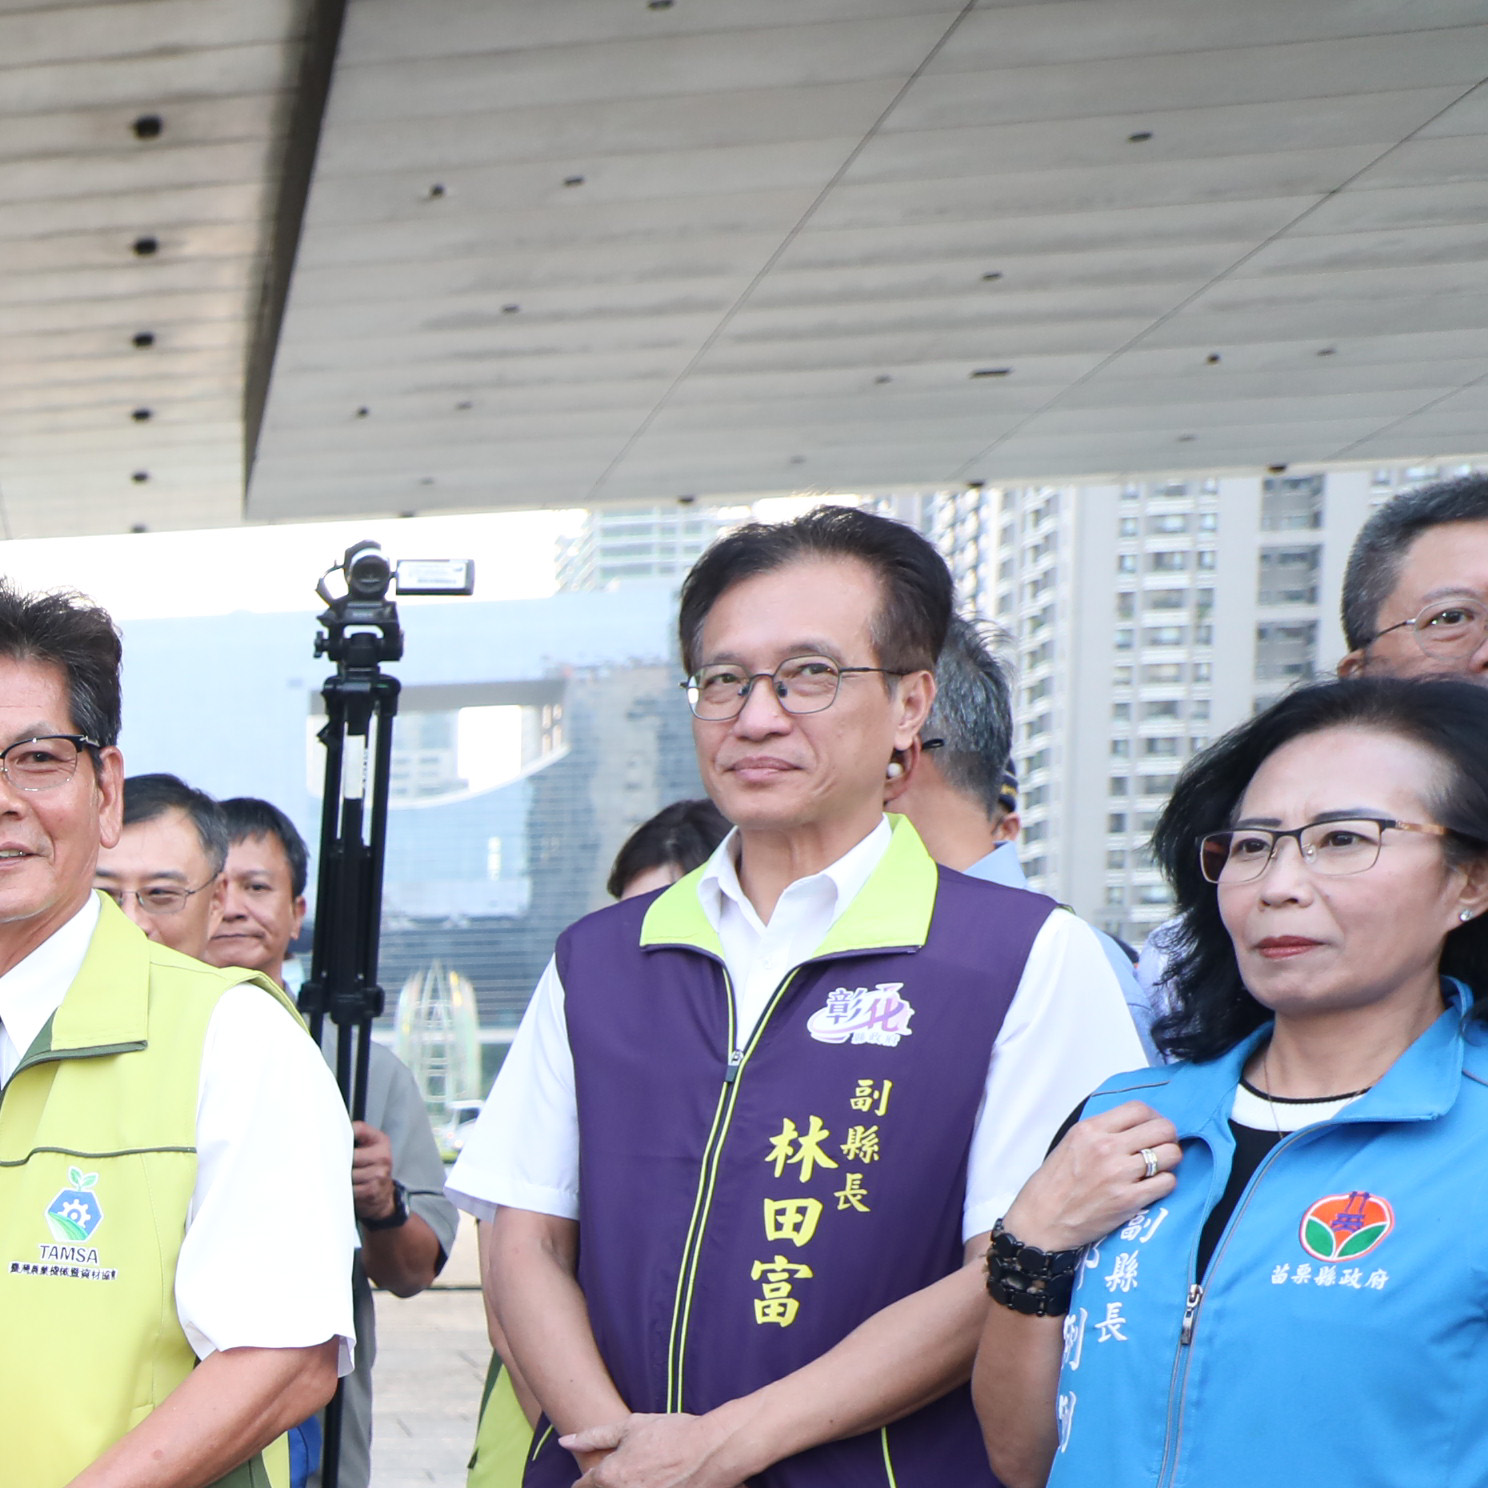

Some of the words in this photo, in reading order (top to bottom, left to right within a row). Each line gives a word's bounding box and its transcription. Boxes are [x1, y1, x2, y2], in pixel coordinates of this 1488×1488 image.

[827, 984, 912, 1034] 彰化
[834, 1079, 892, 1212] 副縣長
[40, 1245, 98, 1264] TAMSA
[751, 1115, 839, 1328] 林田富
[1094, 1206, 1168, 1344] 副縣長
[1271, 1263, 1389, 1290] 苗栗縣政府
